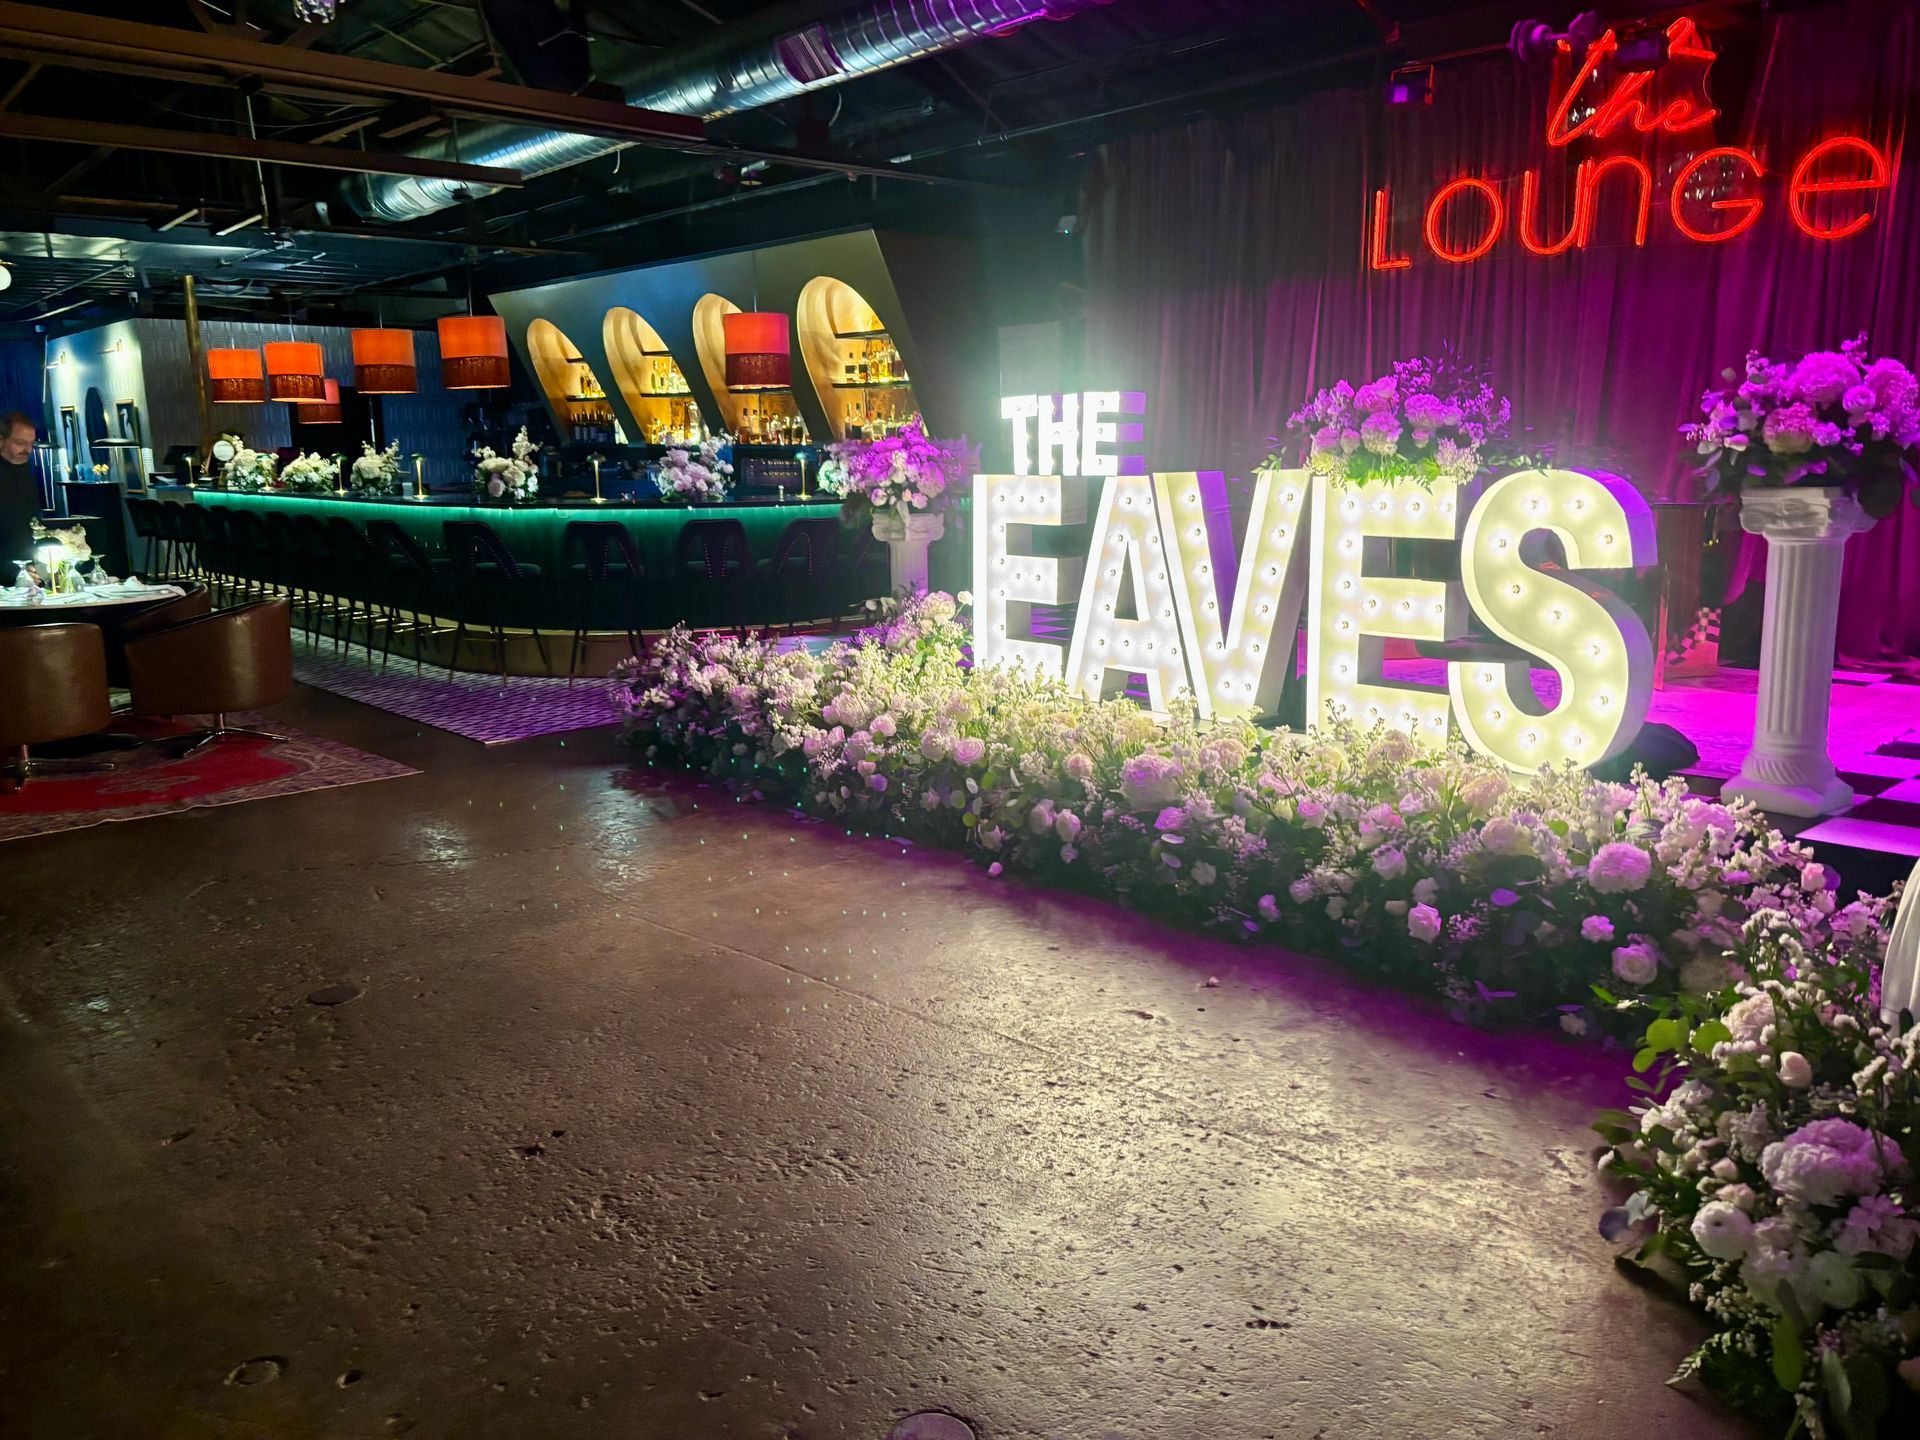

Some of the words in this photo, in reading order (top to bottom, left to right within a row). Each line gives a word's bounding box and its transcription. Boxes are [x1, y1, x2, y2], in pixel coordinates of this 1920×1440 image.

[1547, 17, 1718, 146] the
[1000, 391, 1130, 477] THE
[973, 469, 1650, 775] EAVES
